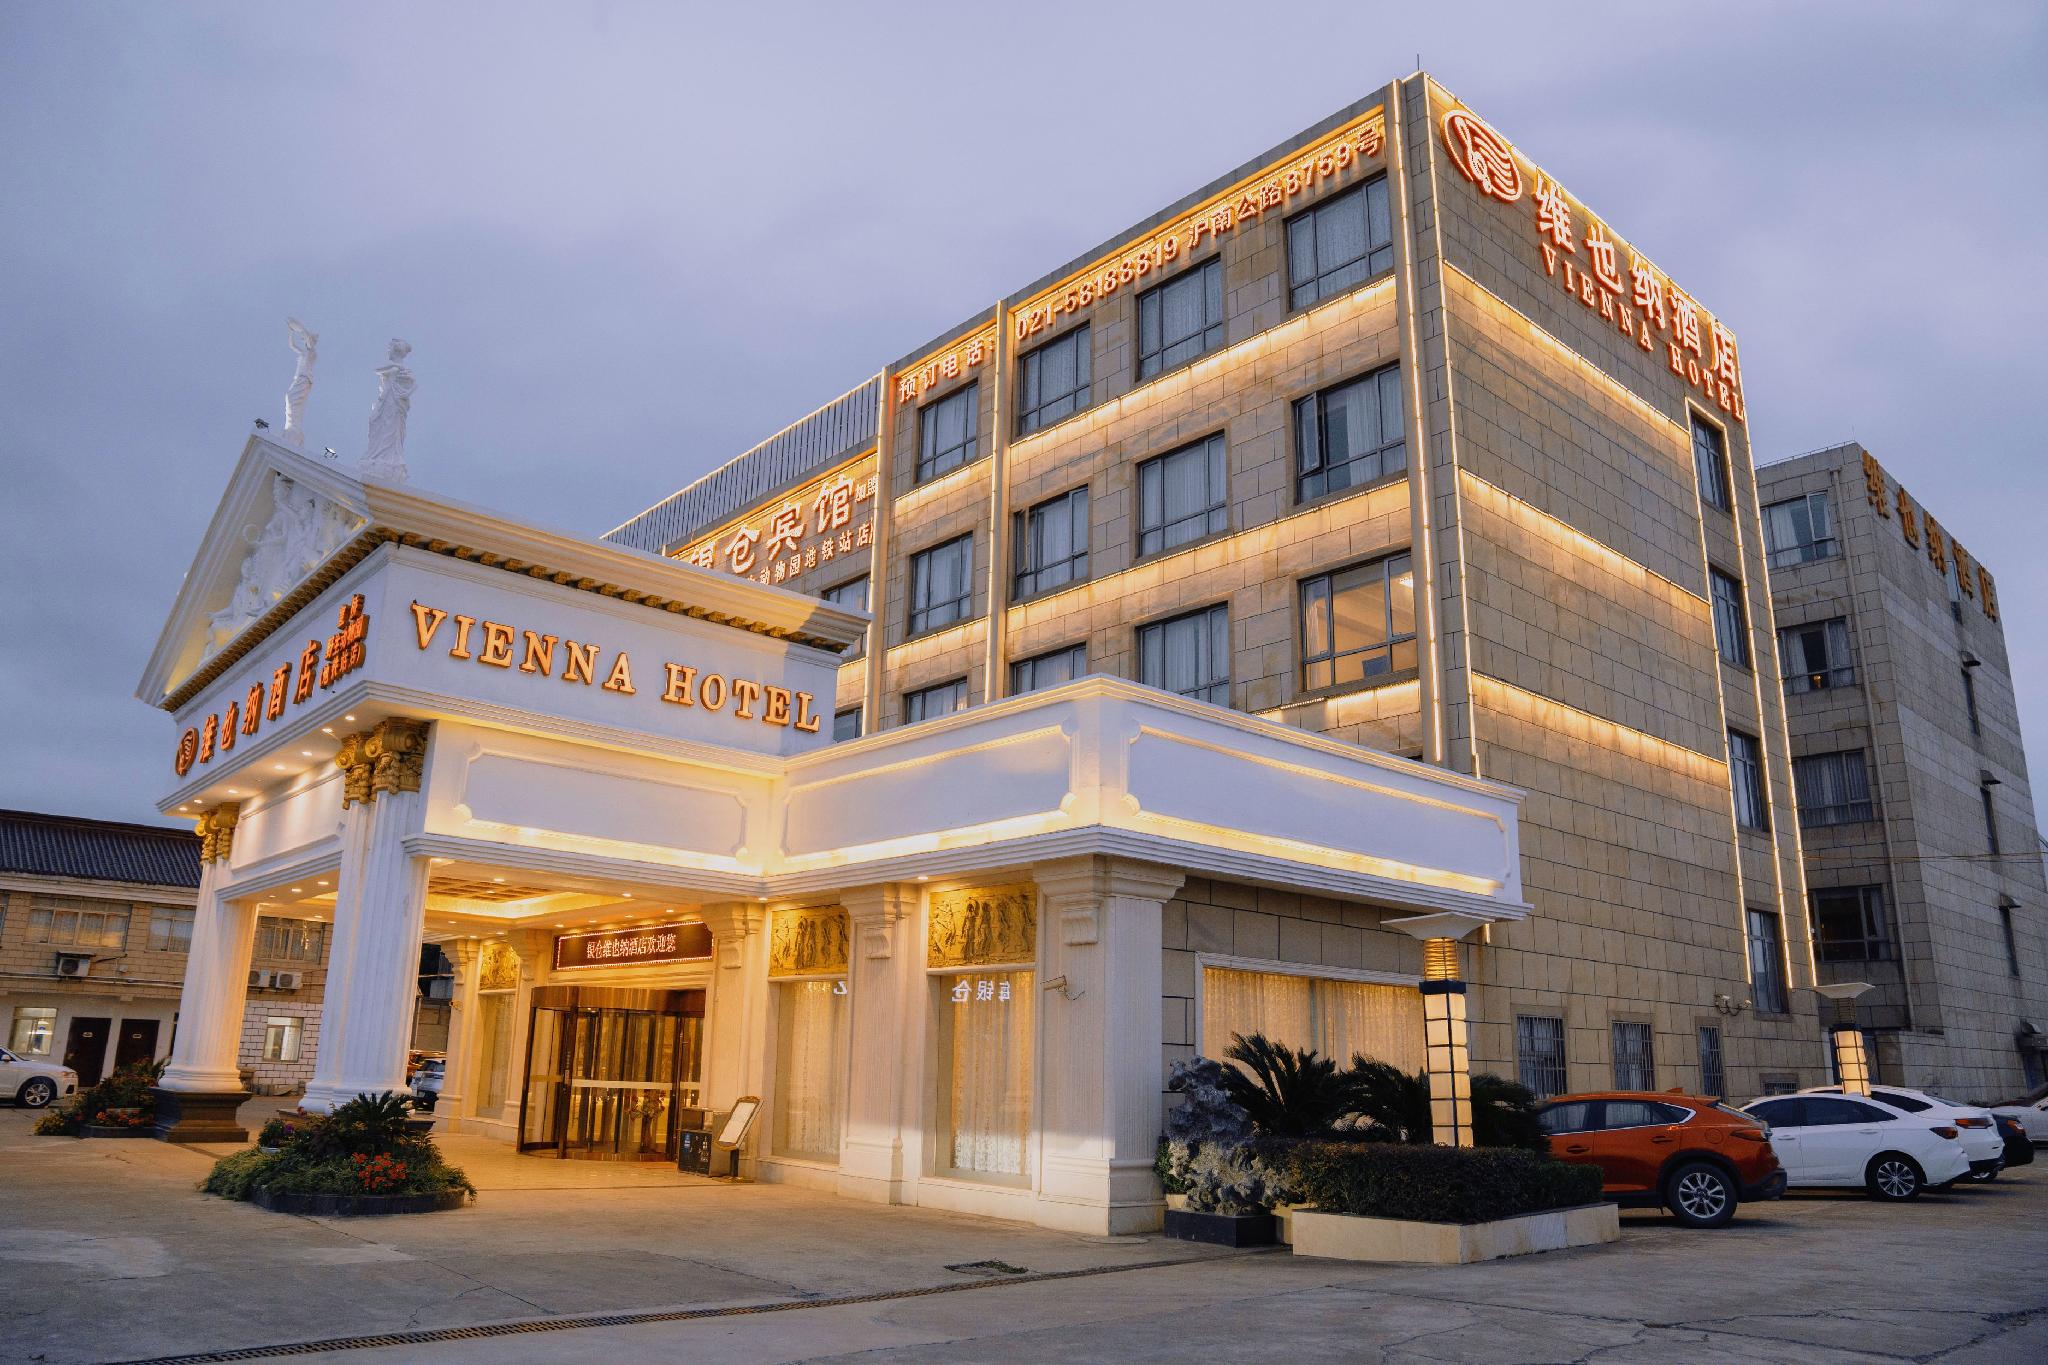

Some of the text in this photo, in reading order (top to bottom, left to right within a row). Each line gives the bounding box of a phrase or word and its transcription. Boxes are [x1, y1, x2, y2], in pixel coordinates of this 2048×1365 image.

[1015, 235, 1180, 341] 021-58188819
[1188, 123, 1381, 249] 沪南公路8759号
[1535, 174, 1738, 388] 维也纳酒店
[1541, 241, 1745, 423] VIENNA HOTEL
[199, 639, 323, 764] 维也纳酒店
[410, 601, 637, 695] VIENNA
[661, 662, 821, 733] HOTEL
